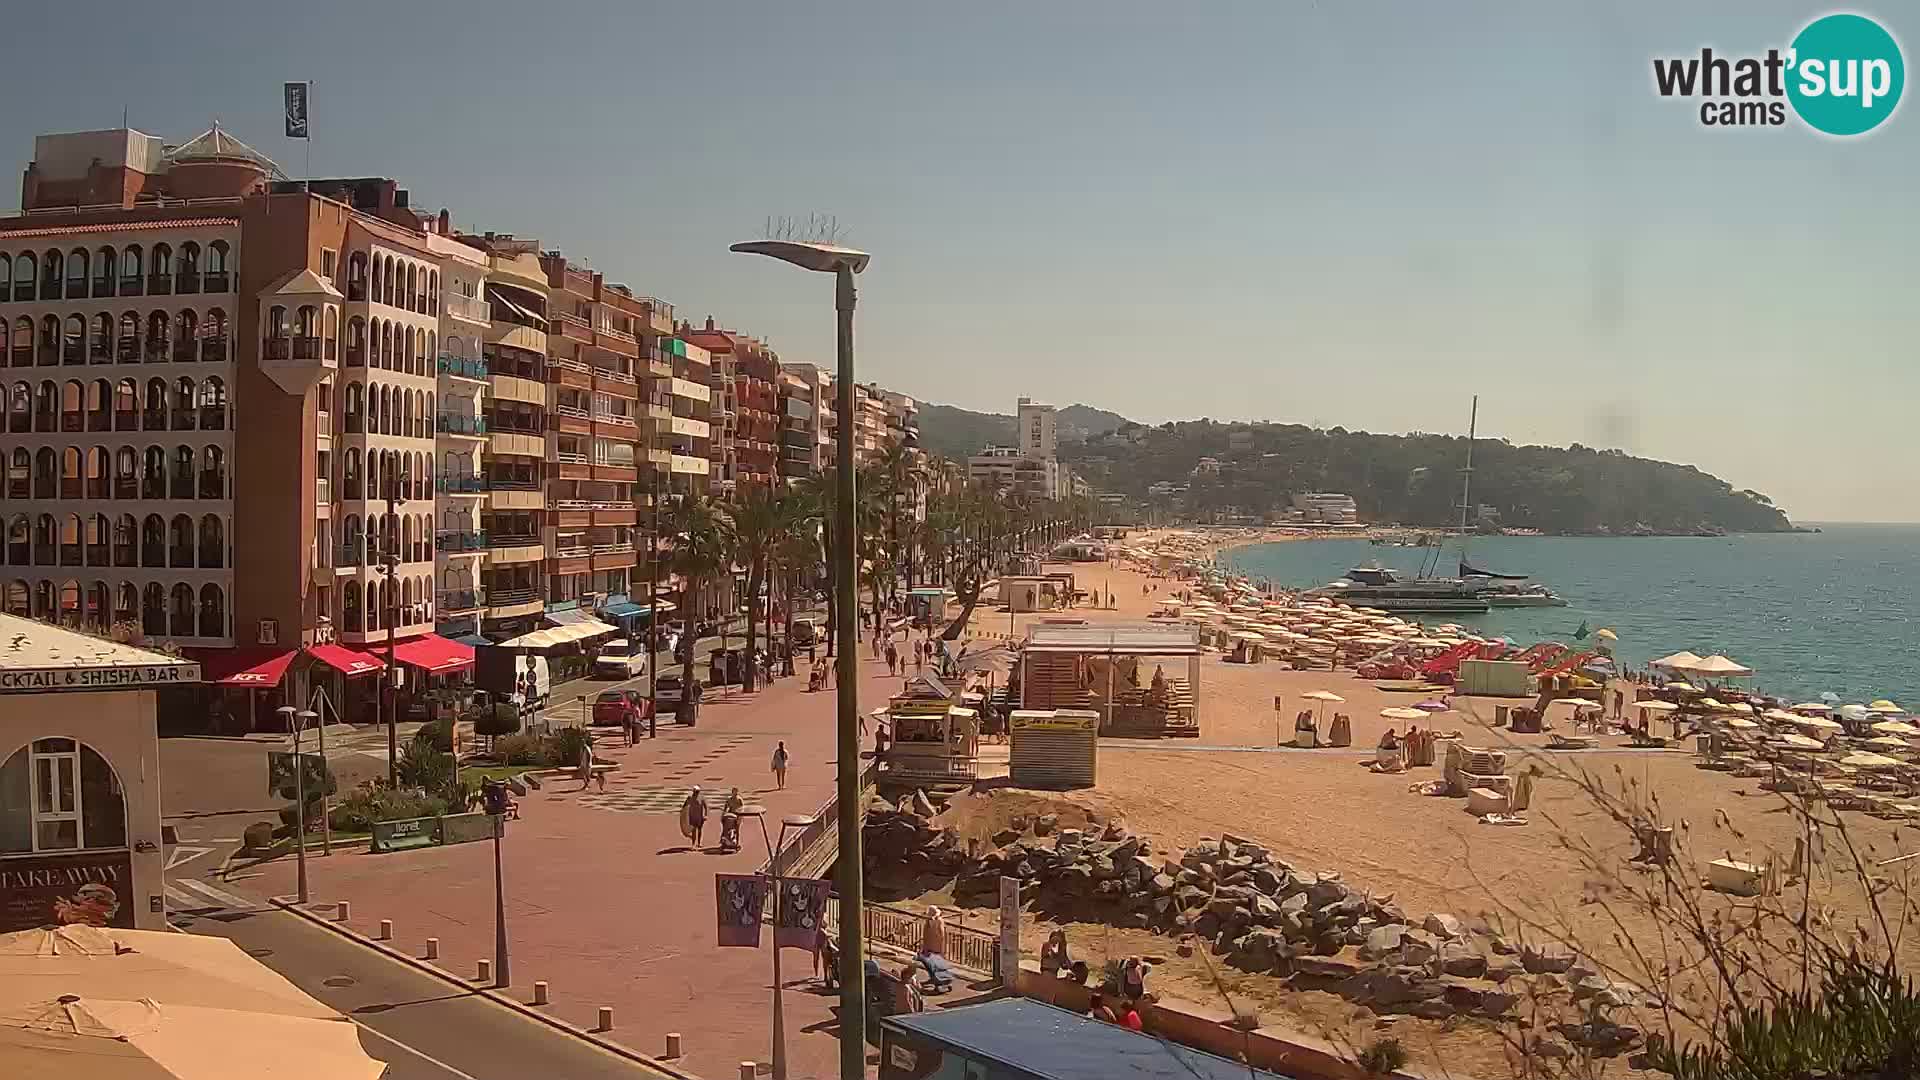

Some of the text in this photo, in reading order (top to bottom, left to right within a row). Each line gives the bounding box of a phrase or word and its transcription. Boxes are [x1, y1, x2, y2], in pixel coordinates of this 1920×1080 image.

[315, 626, 335, 643] KFC
[65, 671, 75, 685] &
[80, 668, 142, 684] SHISHA
[146, 667, 180, 682] BAR
[231, 673, 269, 681] KFC
